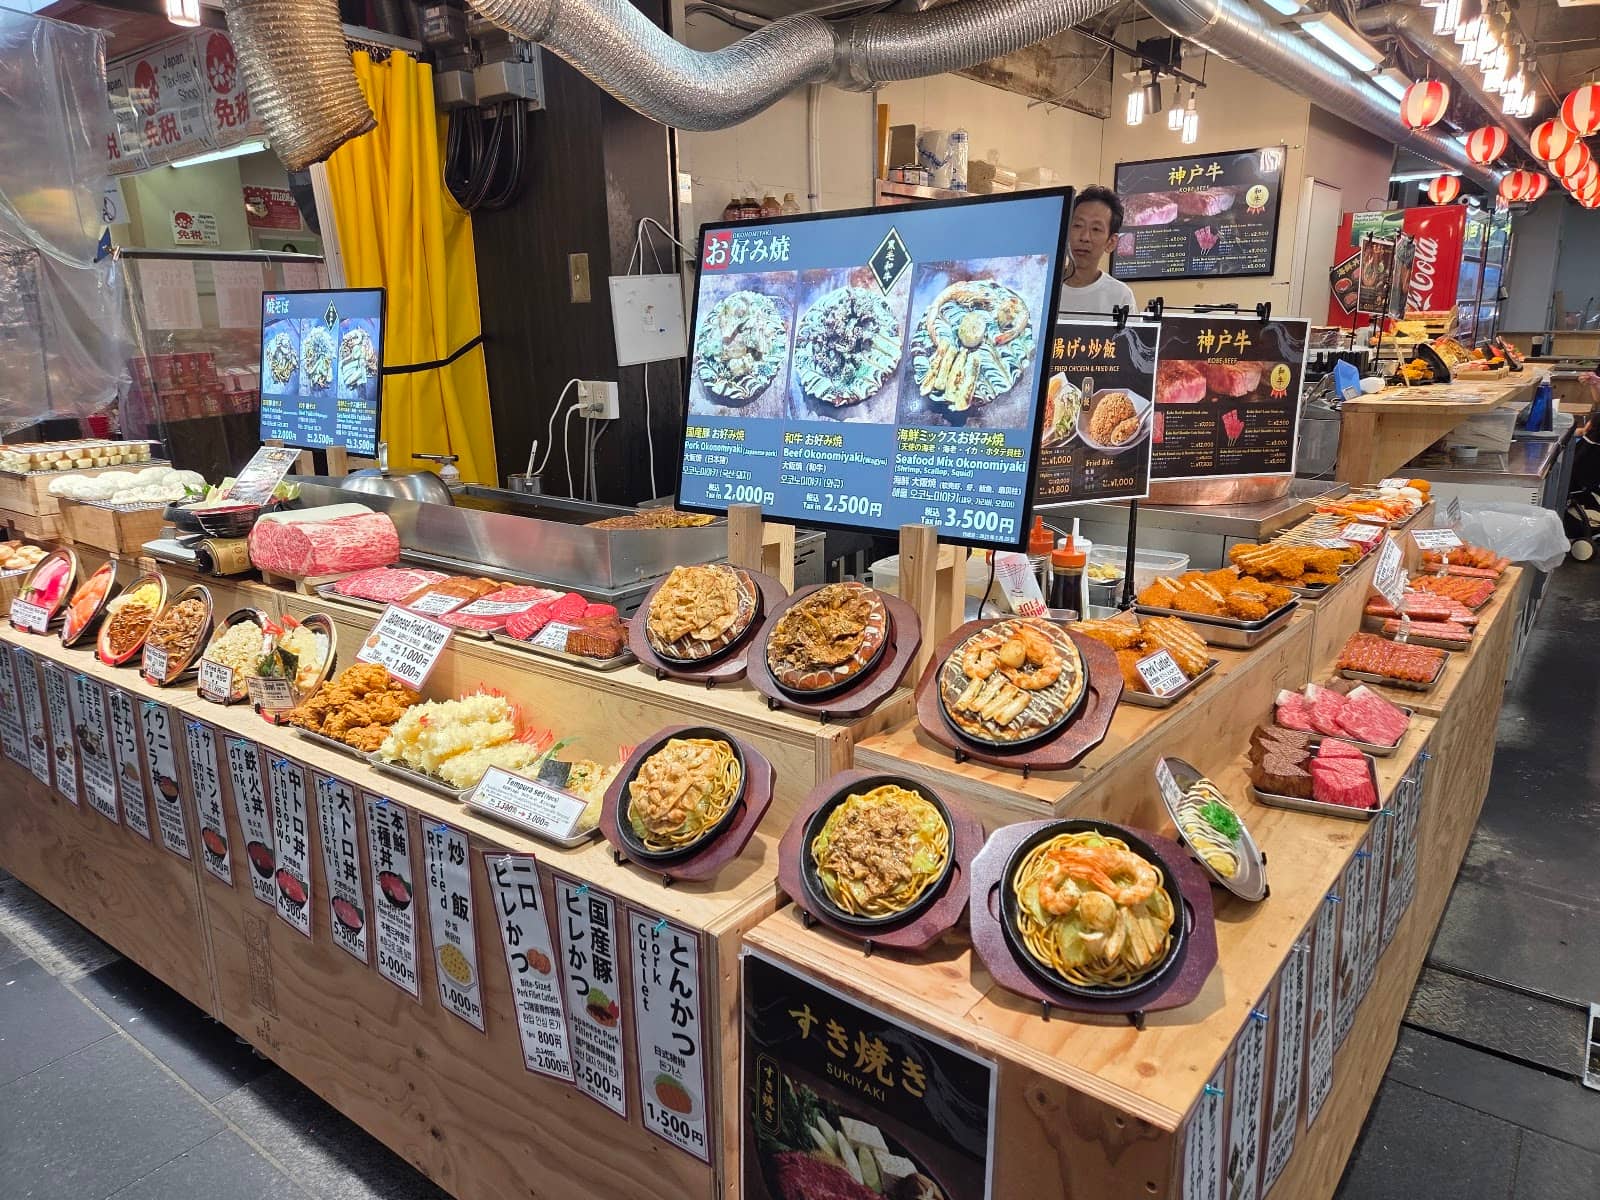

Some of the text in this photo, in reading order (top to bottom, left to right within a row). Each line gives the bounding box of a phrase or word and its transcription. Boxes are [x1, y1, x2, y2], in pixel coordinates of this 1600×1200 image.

[705, 234, 791, 266] お好み焼
[783, 448, 804, 460] Beef
[804, 449, 863, 464] Okonomiyaki
[804, 434, 843, 448] お好み焼
[897, 428, 1005, 450] 海鮮ミックスお好み焼
[895, 453, 1027, 475] Seafood Mix Okonomiyaki
[723, 483, 775, 506] 2,000円
[823, 493, 883, 518] 2,500円
[944, 507, 1015, 535] 3,500円
[391, 659, 421, 681] 1,800円
[400, 646, 429, 668] 1,000円
[121, 699, 136, 753] 牛かつ
[143, 709, 169, 786] ウニ イクラ丼
[201, 731, 221, 821] サーモン丼
[243, 749, 265, 819] 鉄火丼
[506, 777, 534, 795] Tempura
[287, 768, 306, 861] 中トロ丼
[335, 788, 358, 886] 大トロ丼
[376, 805, 395, 872] 三種丼
[426, 829, 470, 923] 炒飯 Fried Rice
[493, 861, 538, 975] 一口 ヒレかつ
[565, 886, 615, 998] 国産豚 ヒレかつ
[379, 951, 416, 984] 5,000円
[637, 922, 651, 1013] Cutlet
[441, 983, 480, 1018] 1,000円
[668, 934, 697, 1058] とんかつ
[537, 1029, 563, 1050] 800円
[569, 1012, 621, 1045] Japanese Pork
[593, 1029, 617, 1053] Cutlet
[537, 1053, 570, 1077] 2,000円
[787, 1003, 928, 1099] すき焼き
[574, 1060, 622, 1103] 2,500円
[761, 1065, 776, 1123] すき焼き
[826, 1062, 886, 1102] SUKIYAKI
[647, 1100, 705, 1147] 1,500円
